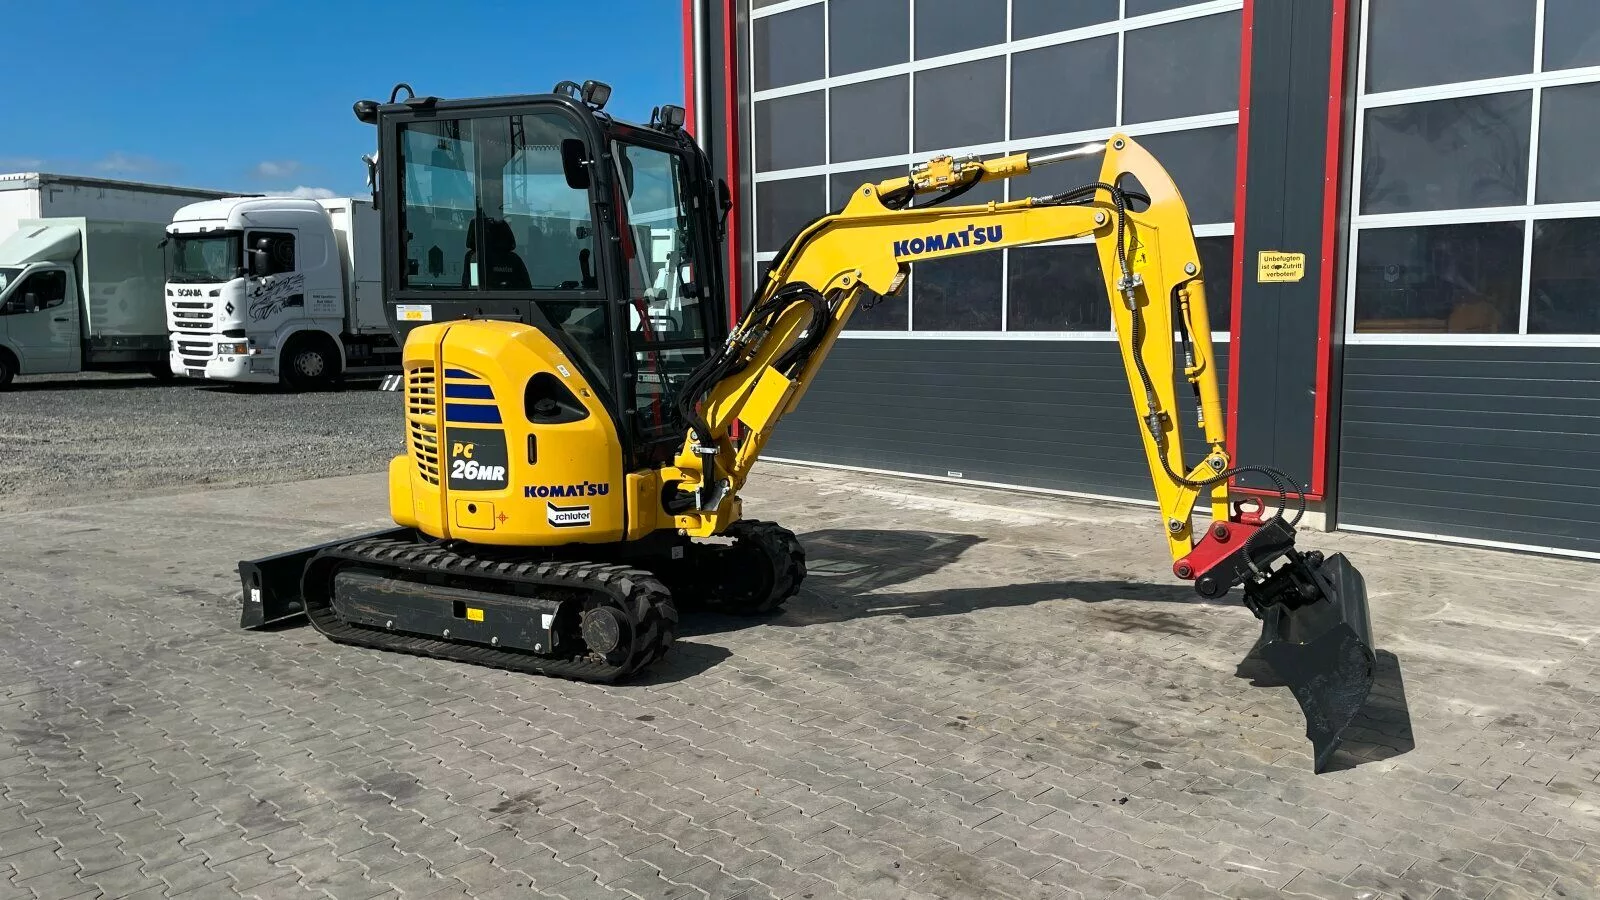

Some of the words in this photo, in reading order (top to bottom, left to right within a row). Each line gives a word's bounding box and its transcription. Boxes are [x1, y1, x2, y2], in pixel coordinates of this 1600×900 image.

[893, 224, 1003, 257] KOMATSU
[178, 288, 203, 297] SCANIA
[452, 443, 474, 459] PC
[451, 460, 506, 481] 26MR
[524, 480, 609, 498] KOMATSU
